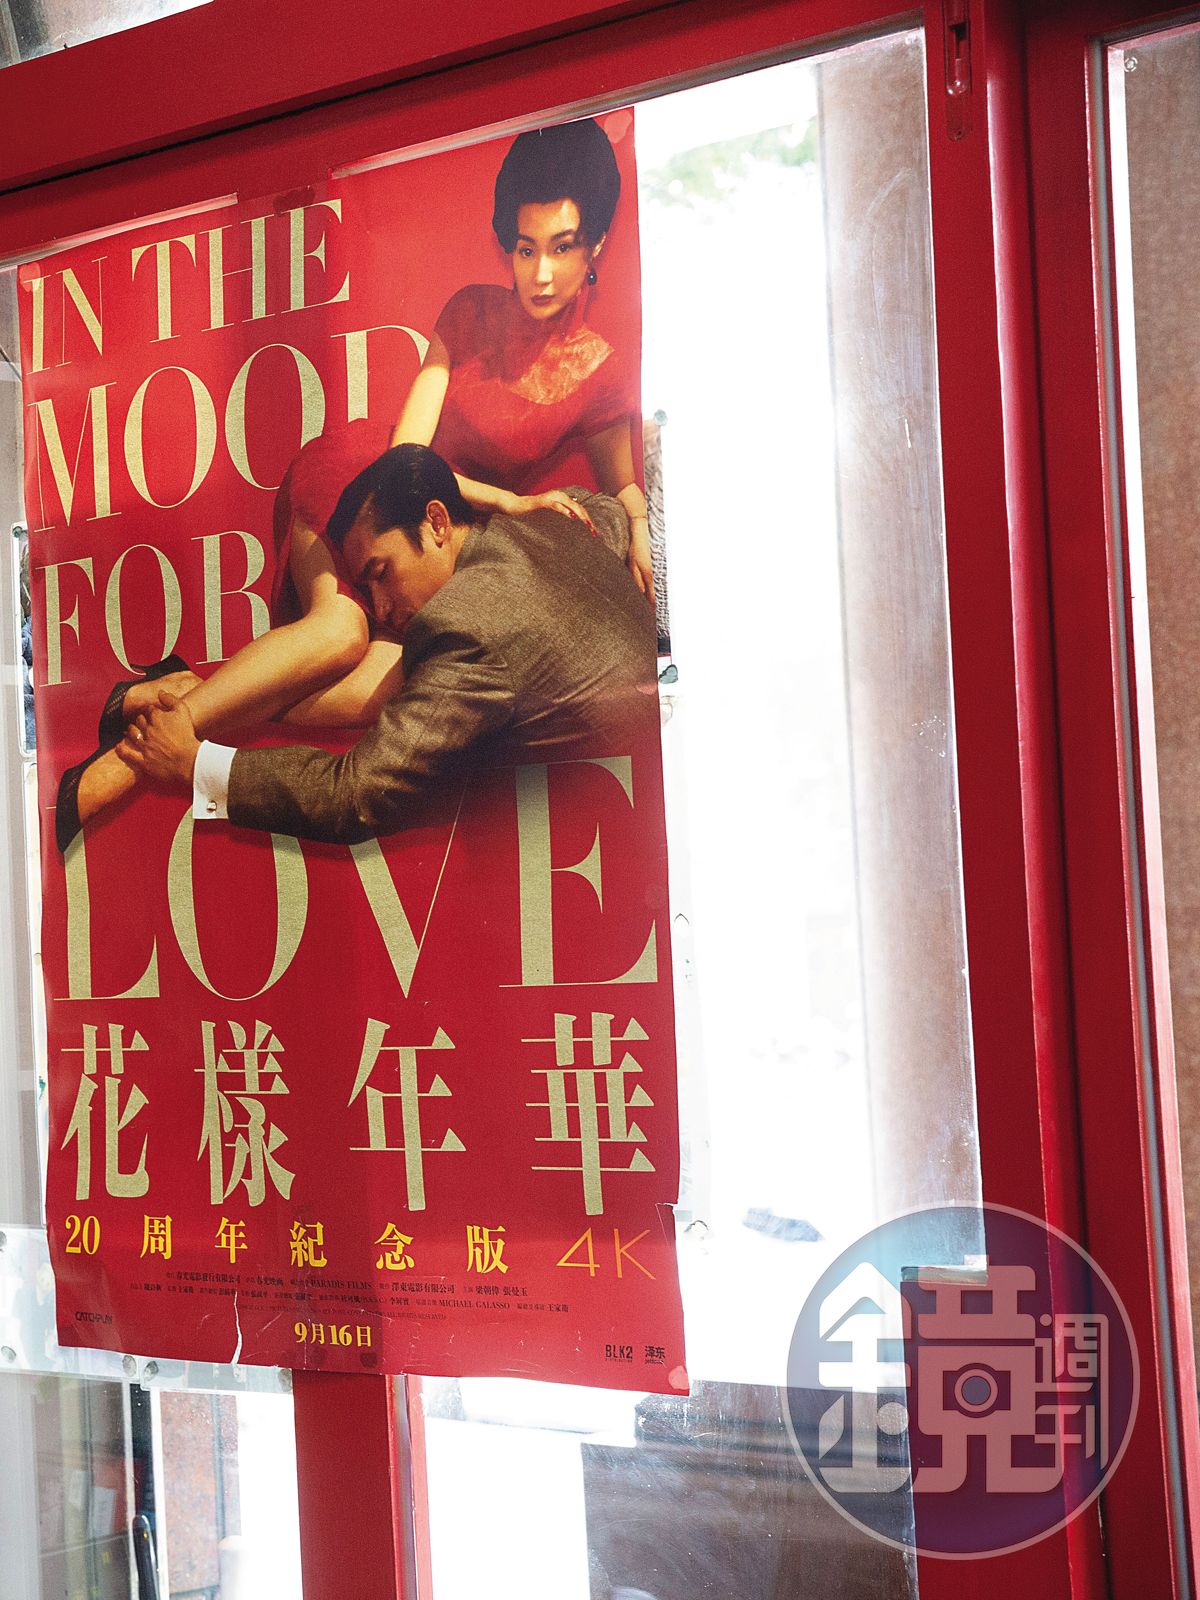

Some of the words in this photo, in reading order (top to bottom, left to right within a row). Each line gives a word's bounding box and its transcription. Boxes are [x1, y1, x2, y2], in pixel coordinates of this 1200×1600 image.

[23, 256, 108, 375] IN
[131, 198, 350, 344] THE
[27, 325, 432, 533] MOOD
[35, 530, 271, 688] FOR
[46, 755, 658, 1001] LOVE
[61, 1011, 657, 1216] 花樣年華
[65, 1214, 101, 1255] 20
[556, 1227, 656, 1280] 4K
[391, 1282, 456, 1295] 澤東電影有限公司
[475, 1285, 500, 1296] 梁朝偉
[503, 1286, 528, 1297] 張曼玉
[439, 1299, 473, 1308] MICHAEL
[475, 1301, 510, 1310] GALASSO
[294, 1322, 372, 1348] 9月16日
[605, 1344, 633, 1359] BLK2
[644, 1345, 666, 1359] 泽东
